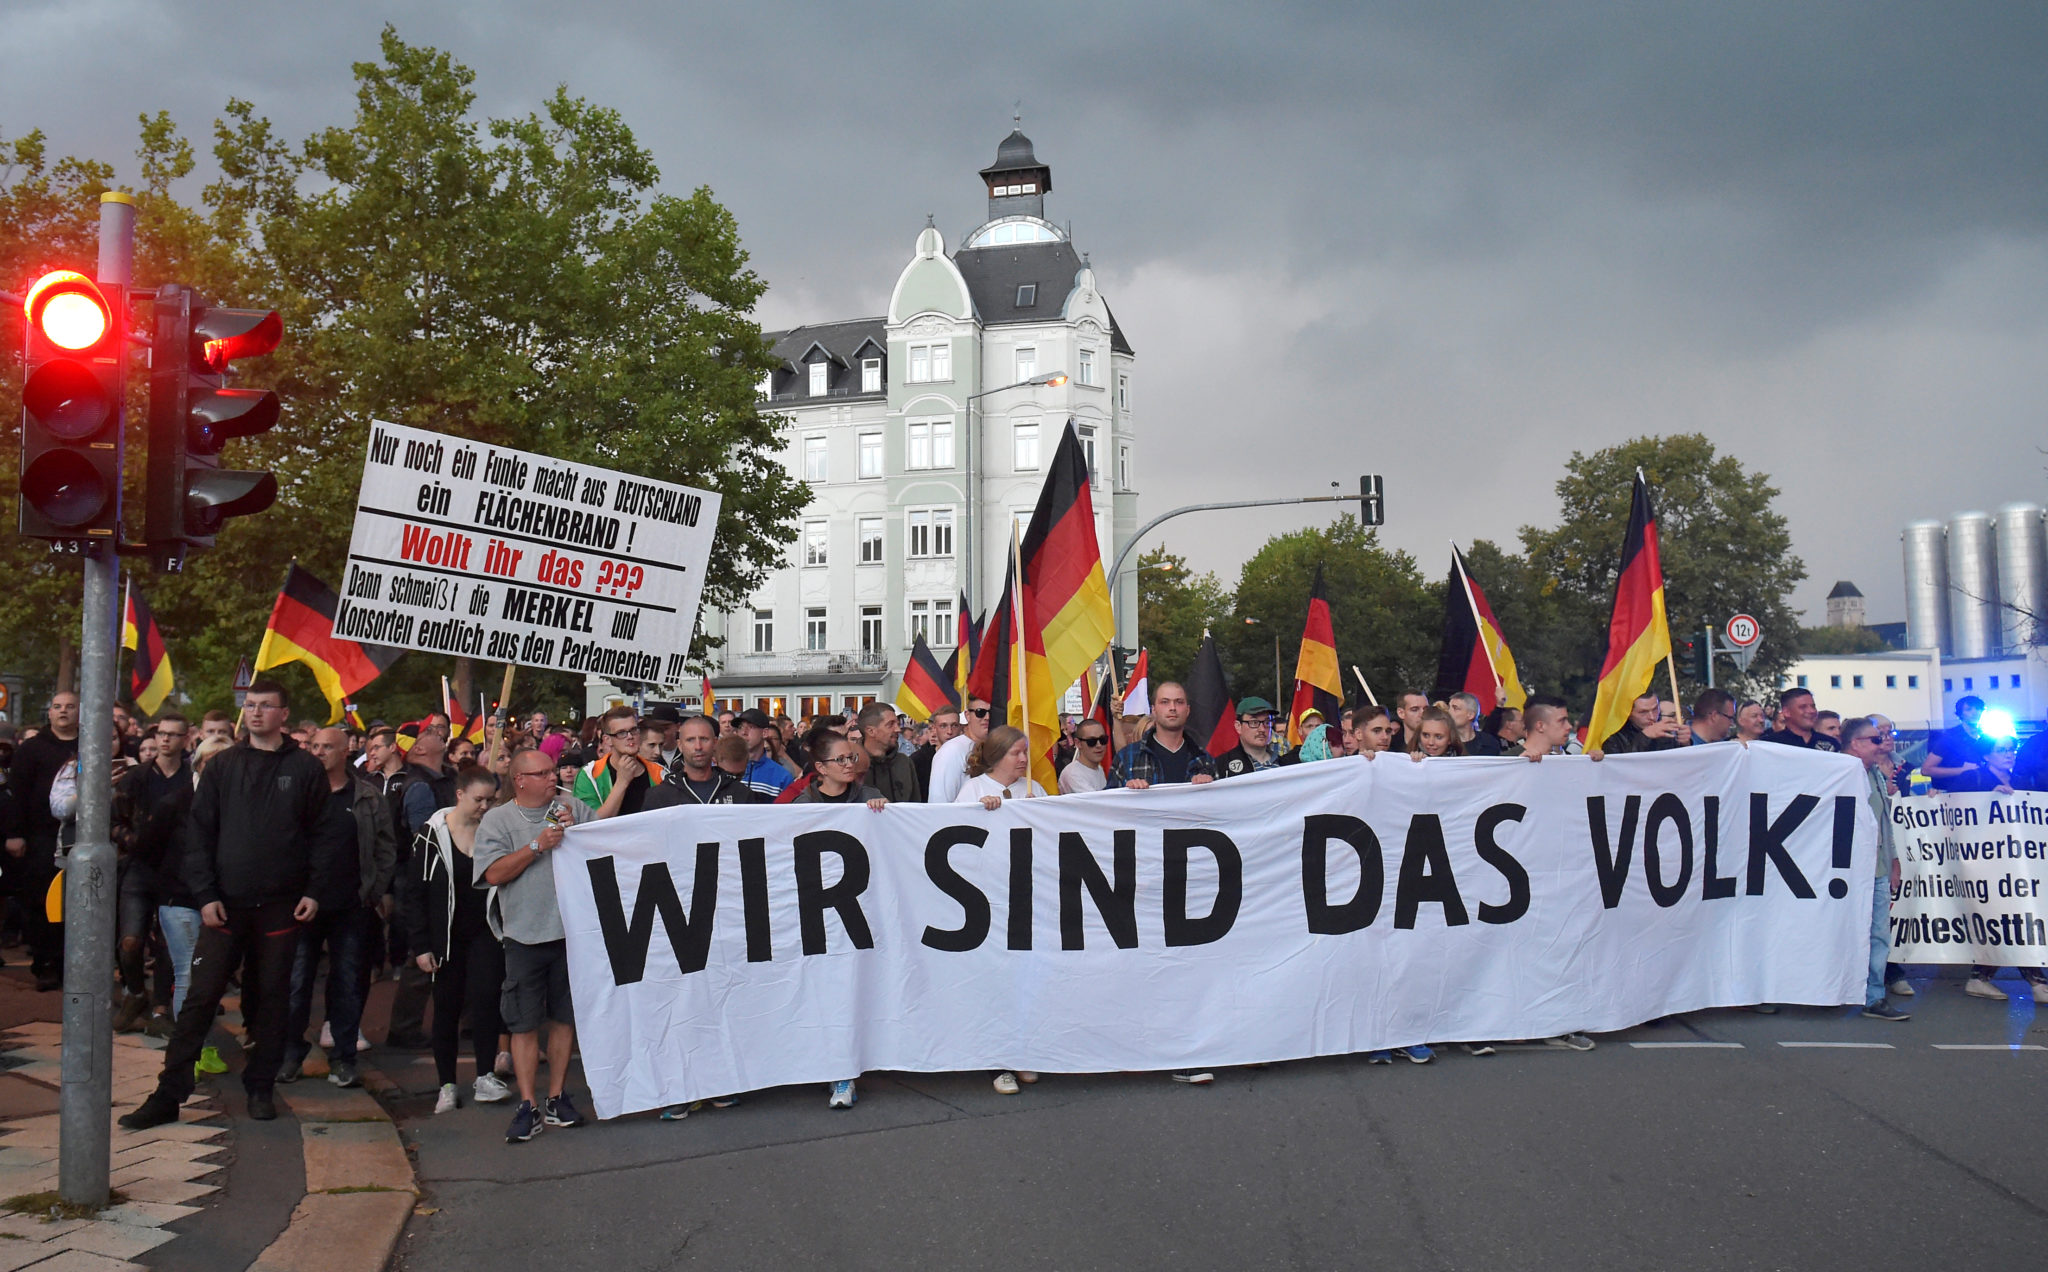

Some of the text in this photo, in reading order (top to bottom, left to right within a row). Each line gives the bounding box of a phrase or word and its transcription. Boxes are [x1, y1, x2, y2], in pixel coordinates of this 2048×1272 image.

[370, 428, 701, 527] Nur noch ein Funke macht aus DEUTSCHLAND
[417, 481, 451, 516] ein
[474, 491, 620, 549] FLÄCHENBRAND
[401, 524, 643, 598] Wollt ihr das ???
[348, 564, 382, 600] Dann
[469, 584, 489, 616] die
[502, 588, 594, 633] MERKEL
[611, 608, 640, 640] und
[336, 599, 414, 644] Konsorten
[418, 619, 484, 655] endlich
[487, 630, 519, 662] aus
[521, 631, 554, 665] den
[559, 636, 661, 685] Parlamenten
[1230, 762, 1241, 771] 37
[586, 793, 1855, 986] WIR SIND DAS VOLK!
[1999, 873, 2040, 898] der
